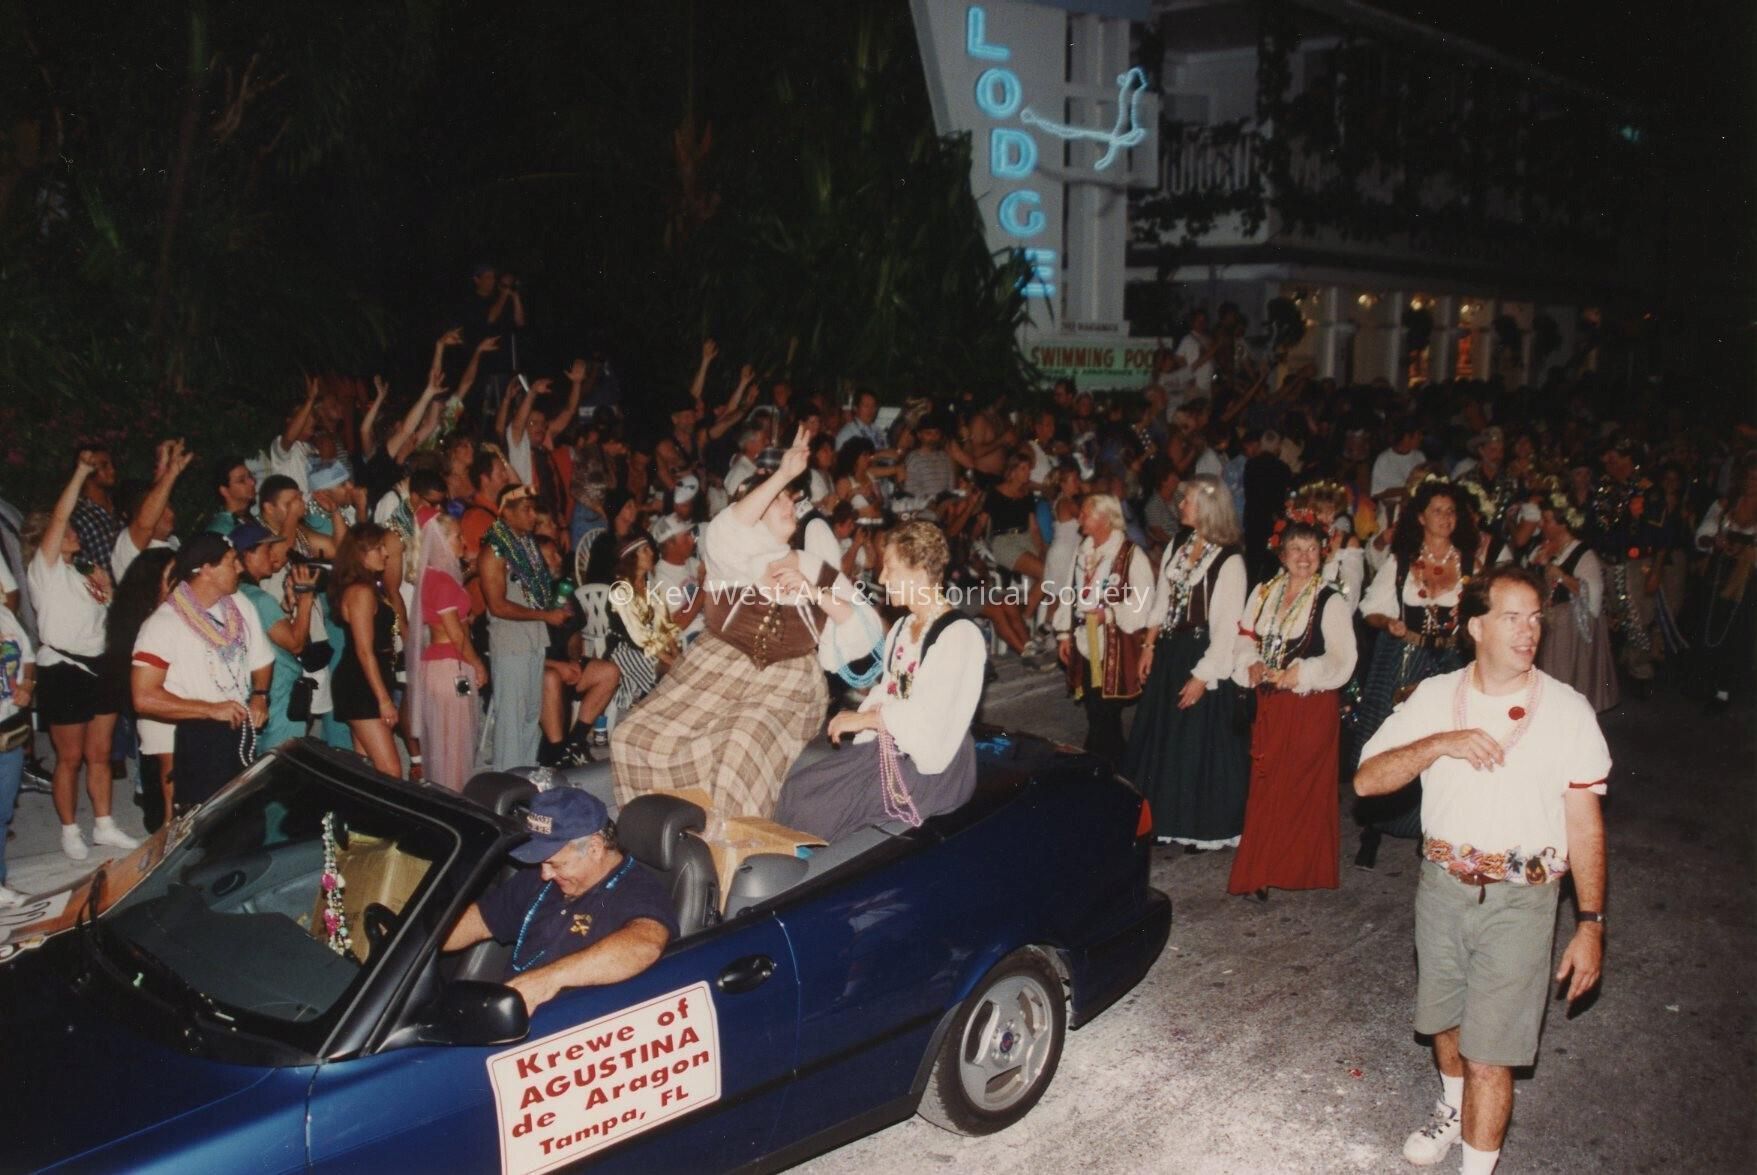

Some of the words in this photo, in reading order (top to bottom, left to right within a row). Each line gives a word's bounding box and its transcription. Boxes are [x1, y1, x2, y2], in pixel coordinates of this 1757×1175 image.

[966, 5, 1056, 298] LODGE
[1031, 346, 1114, 368] SWIMMING
[1123, 348, 1154, 368] POO
[516, 1025, 635, 1079] Krewe
[657, 997, 689, 1027] of
[520, 1026, 700, 1110] AGUSTINA
[512, 1111, 557, 1138] de
[585, 1050, 710, 1111] Aragon
[539, 1108, 646, 1155] Tampa,
[660, 1085, 689, 1107] FL
